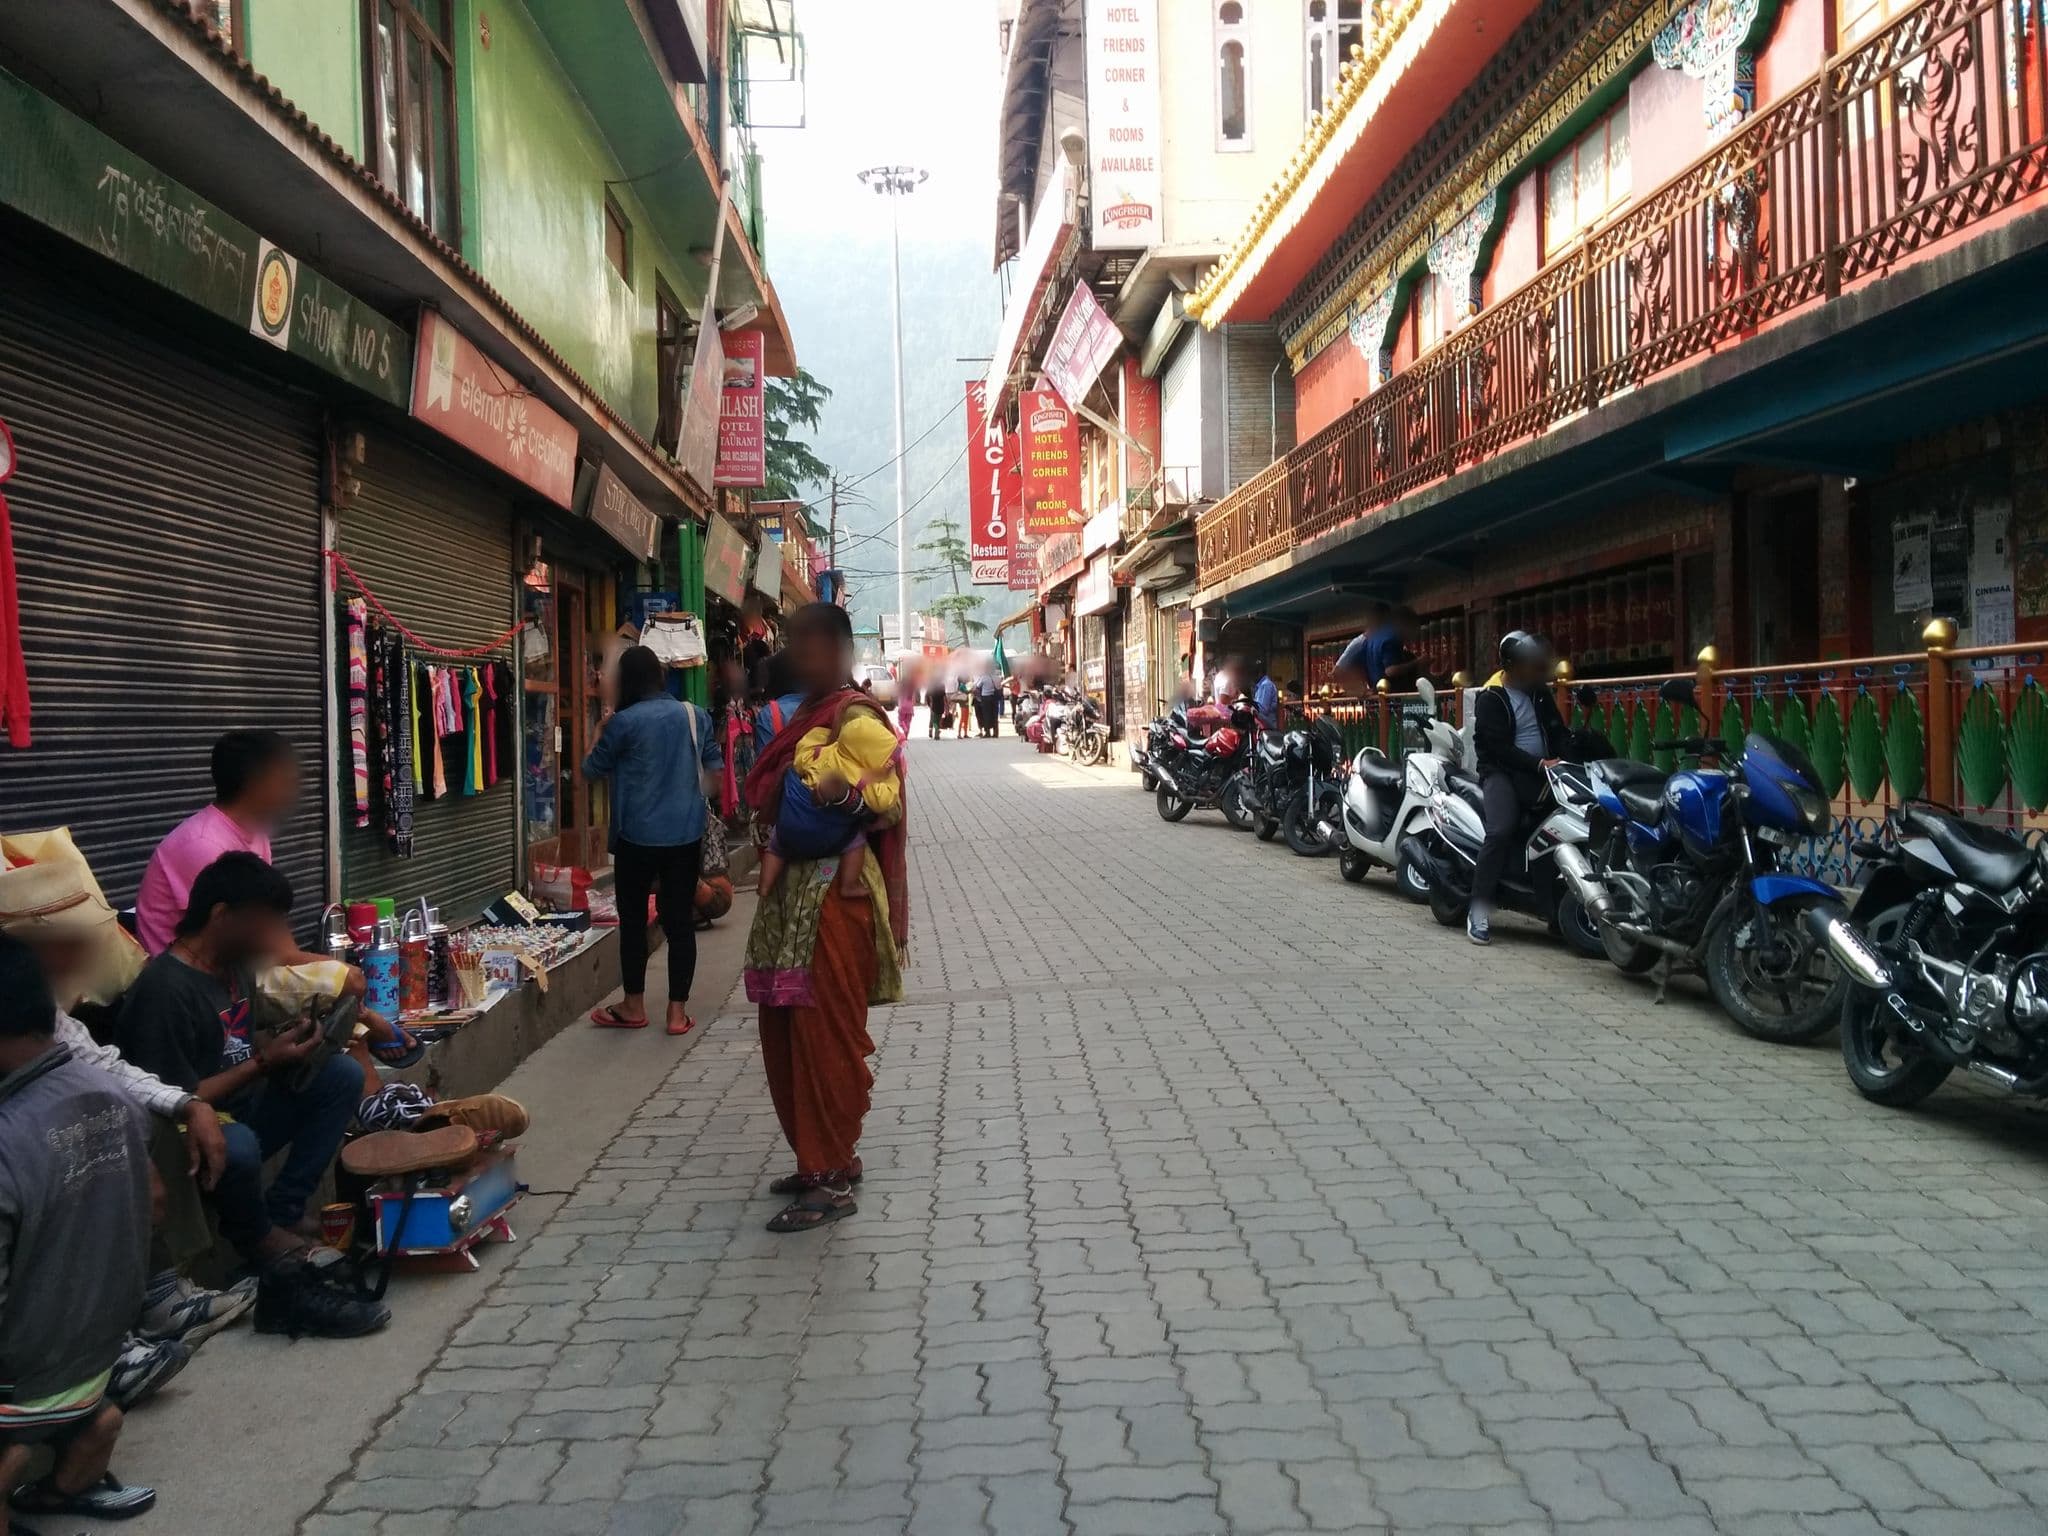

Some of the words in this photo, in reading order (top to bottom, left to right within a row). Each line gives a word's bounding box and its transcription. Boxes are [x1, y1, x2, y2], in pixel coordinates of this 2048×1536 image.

[1107, 7, 1140, 23] HOTEL
[1103, 37, 1146, 53] FRIENDS
[1105, 67, 1146, 83] CORNER
[1122, 97, 1129, 112] &
[1109, 127, 1145, 143] ROOMS
[1101, 156, 1155, 172] AVAILABLE
[352, 322, 376, 371] NO
[720, 394, 760, 418] ILASH
[460, 371, 507, 433] eternal
[528, 426, 569, 478] creation
[721, 421, 754, 432] OTEL
[720, 436, 758, 447] TAURANT
[1034, 433, 1064, 445] HOTEL
[1031, 449, 1069, 461] FRIENDS
[1032, 466, 1069, 478] CORNER
[1047, 483, 1054, 494] &
[1036, 500, 1068, 511] ROOMS
[1029, 515, 1077, 528] AVAILABLE
[972, 543, 1008, 557] Restaur
[1015, 543, 1040, 551] FRIEND
